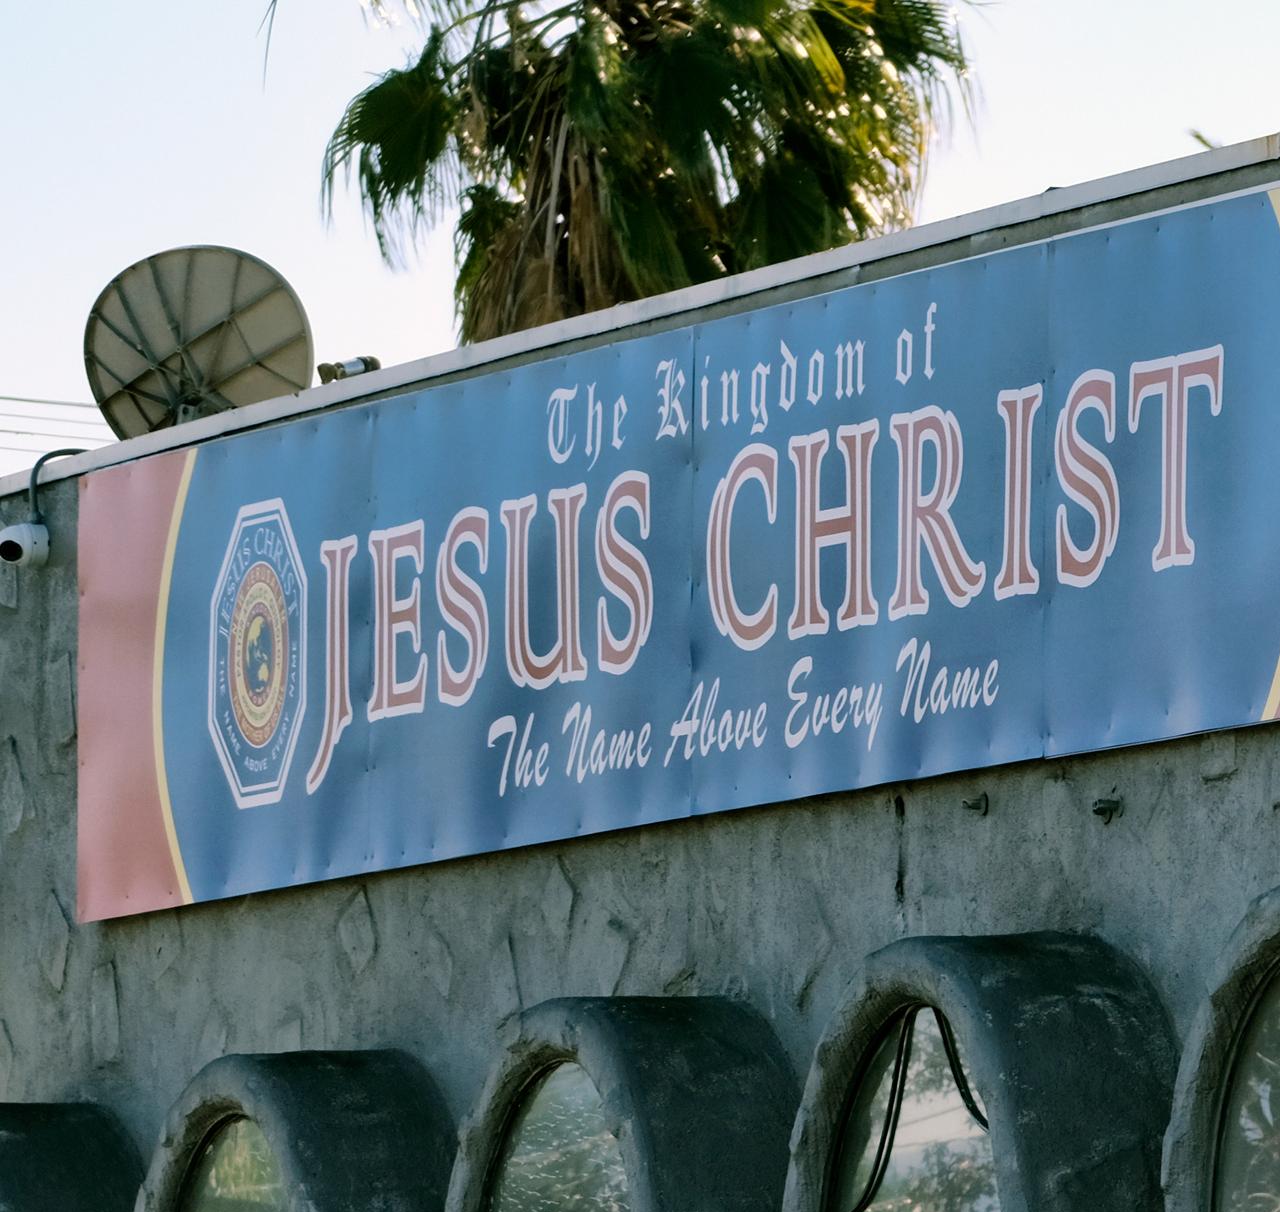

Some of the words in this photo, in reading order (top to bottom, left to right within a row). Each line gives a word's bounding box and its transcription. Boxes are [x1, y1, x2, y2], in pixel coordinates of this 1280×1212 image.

[546, 382, 629, 472] The
[655, 338, 866, 441] Kingdom
[894, 302, 938, 386] of
[219, 537, 251, 638] JESUS
[254, 527, 299, 617] CHRIST
[306, 469, 654, 795] JESUS
[705, 343, 1225, 652] CHRIST
[244, 756, 268, 773] ABOVE
[487, 712, 550, 797] The
[562, 701, 652, 784] Name
[663, 677, 768, 768] Above
[784, 656, 883, 752] Every
[895, 637, 1000, 724] Name
